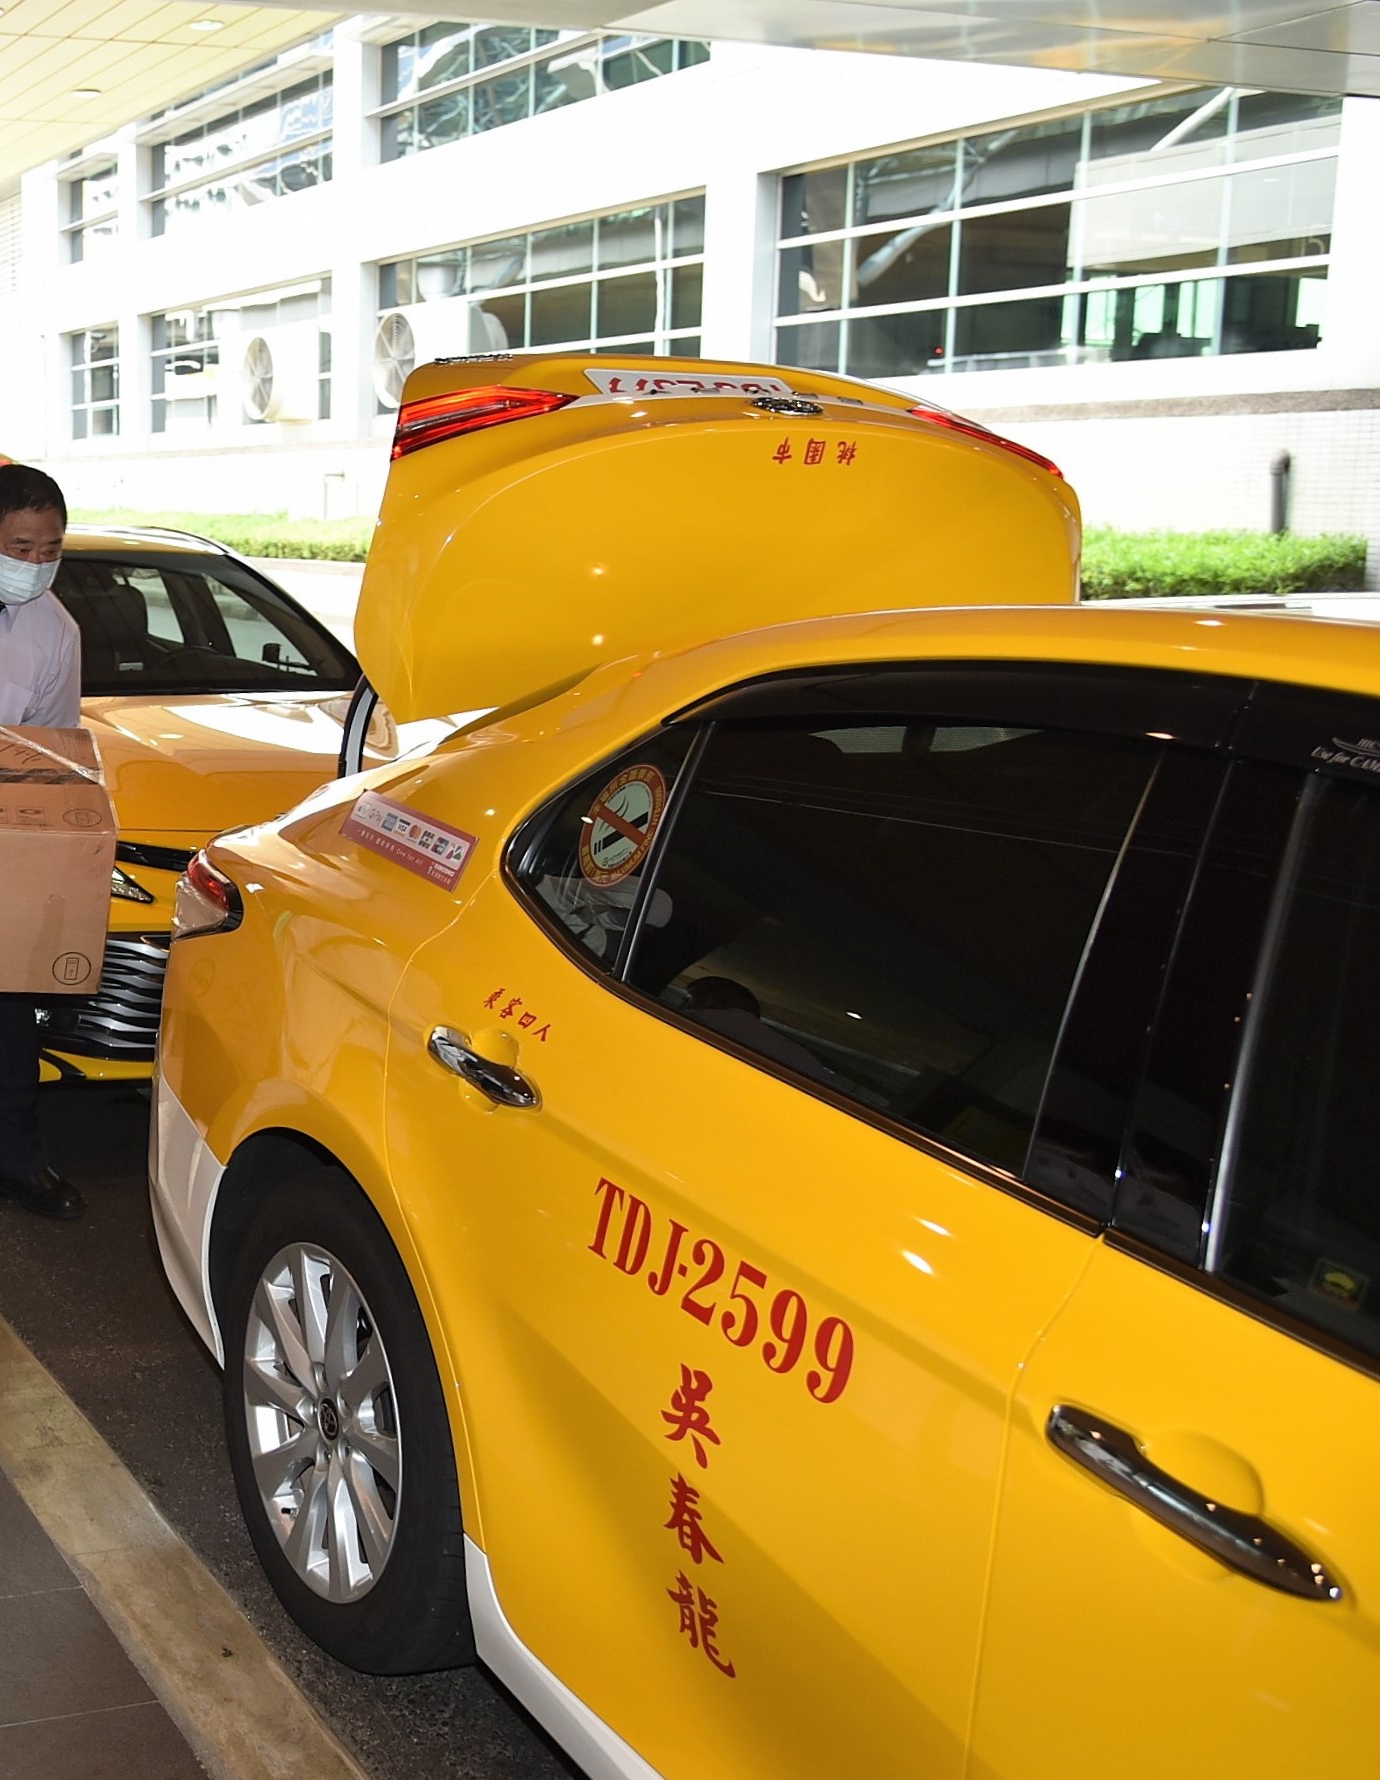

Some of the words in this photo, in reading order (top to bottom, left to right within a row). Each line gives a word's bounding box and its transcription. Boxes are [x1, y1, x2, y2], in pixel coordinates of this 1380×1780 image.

[772, 436, 858, 466] 桃園市
[1310, 746, 1333, 760] Use
[483, 987, 551, 1042] 乘客四人
[586, 1176, 855, 1405] TDJ-2599
[660, 1362, 737, 1680] 吳春龍
